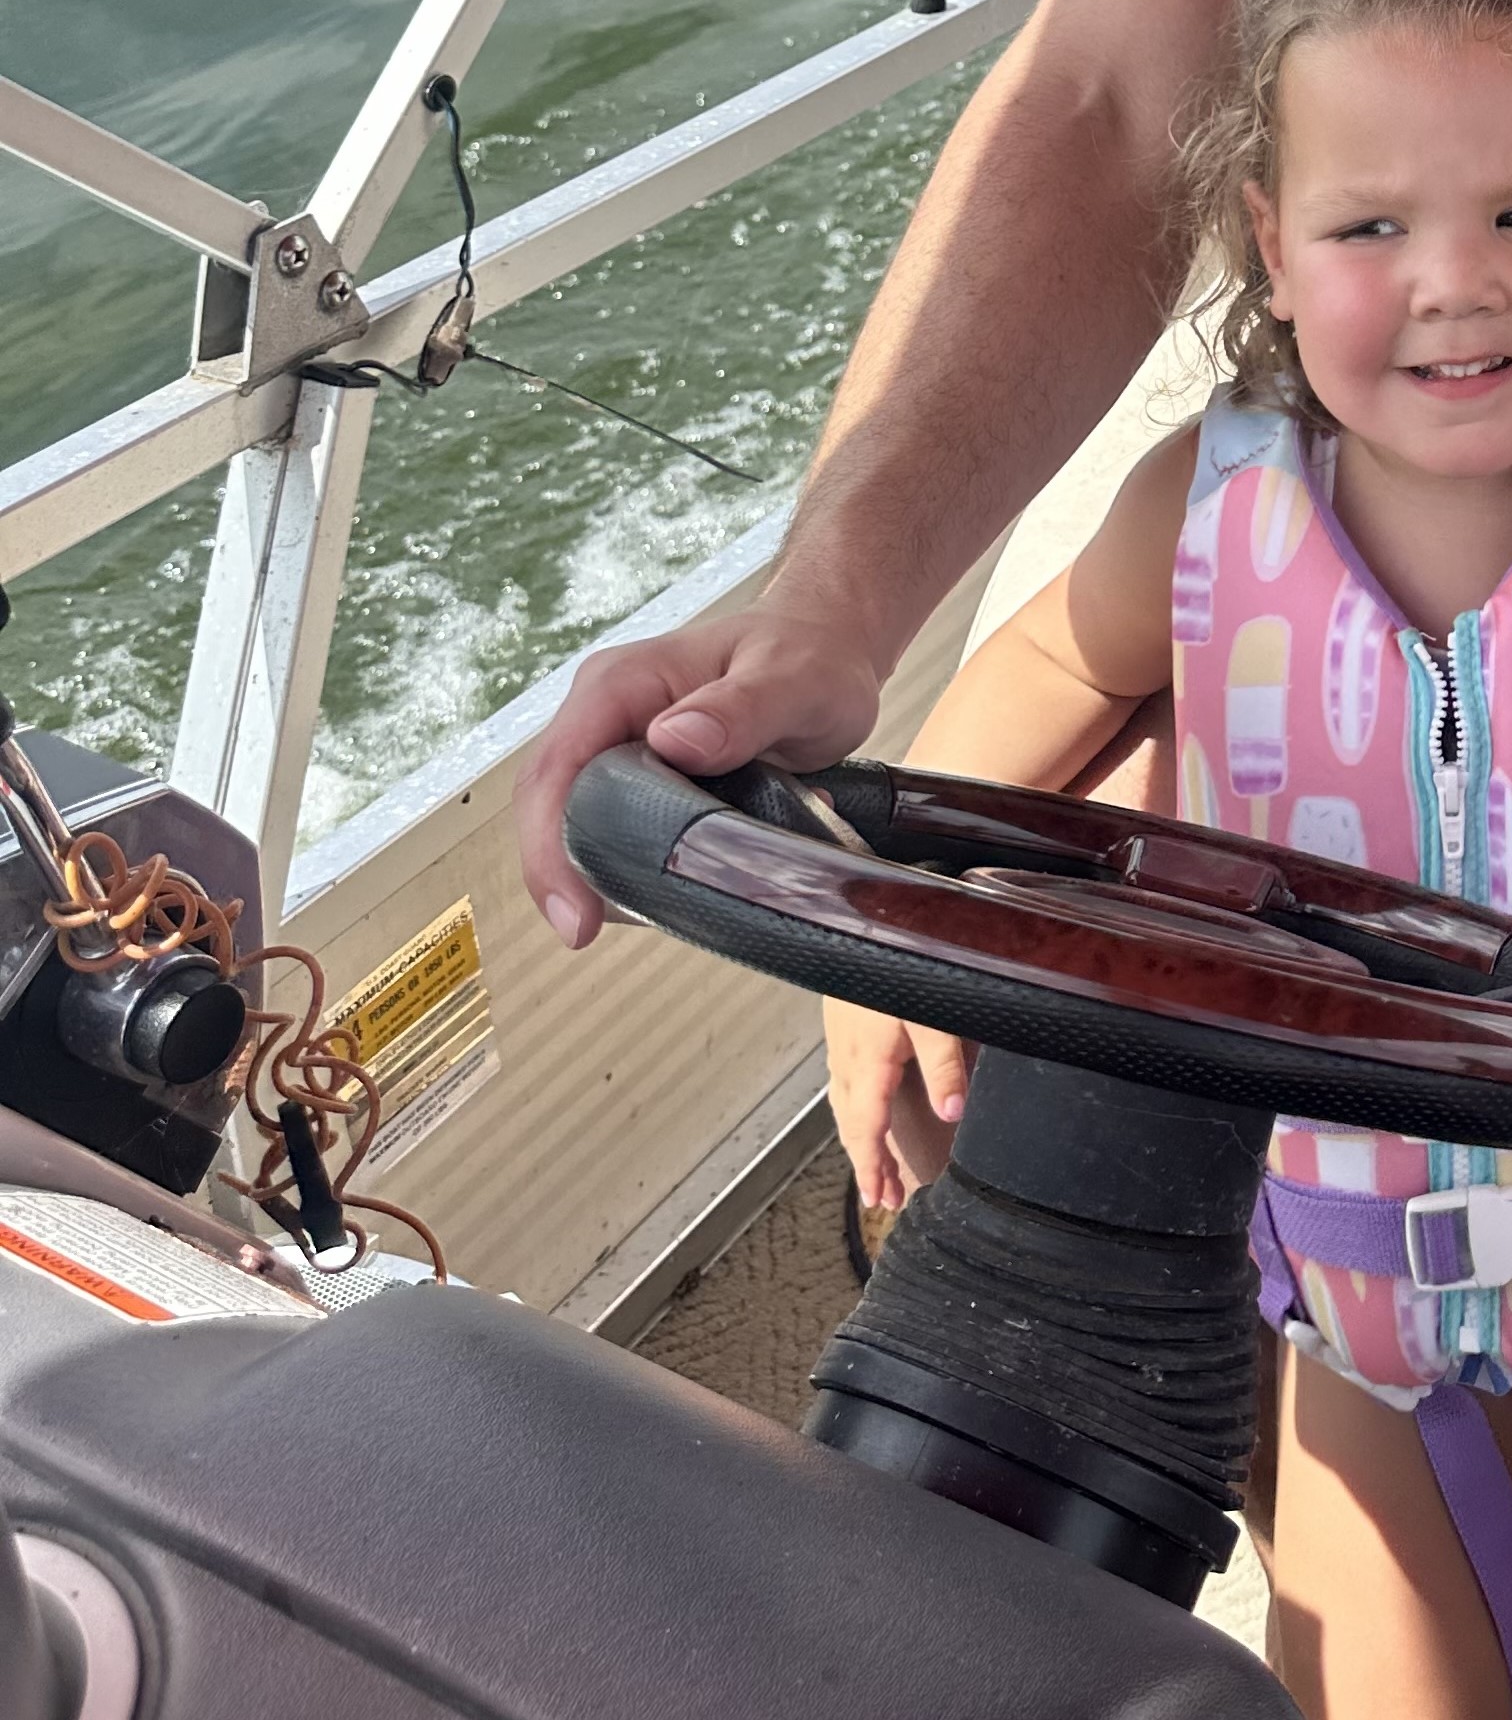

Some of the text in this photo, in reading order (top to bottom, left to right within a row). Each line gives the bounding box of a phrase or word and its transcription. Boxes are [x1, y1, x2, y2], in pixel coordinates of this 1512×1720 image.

[334, 971, 395, 1026] MAXIMUM
[399, 910, 468, 973] CAPACITIES
[368, 986, 406, 1024] PERSONS
[408, 975, 420, 992] OR
[446, 939, 461, 960] LBS
[2, 1230, 105, 1288] WARNING
